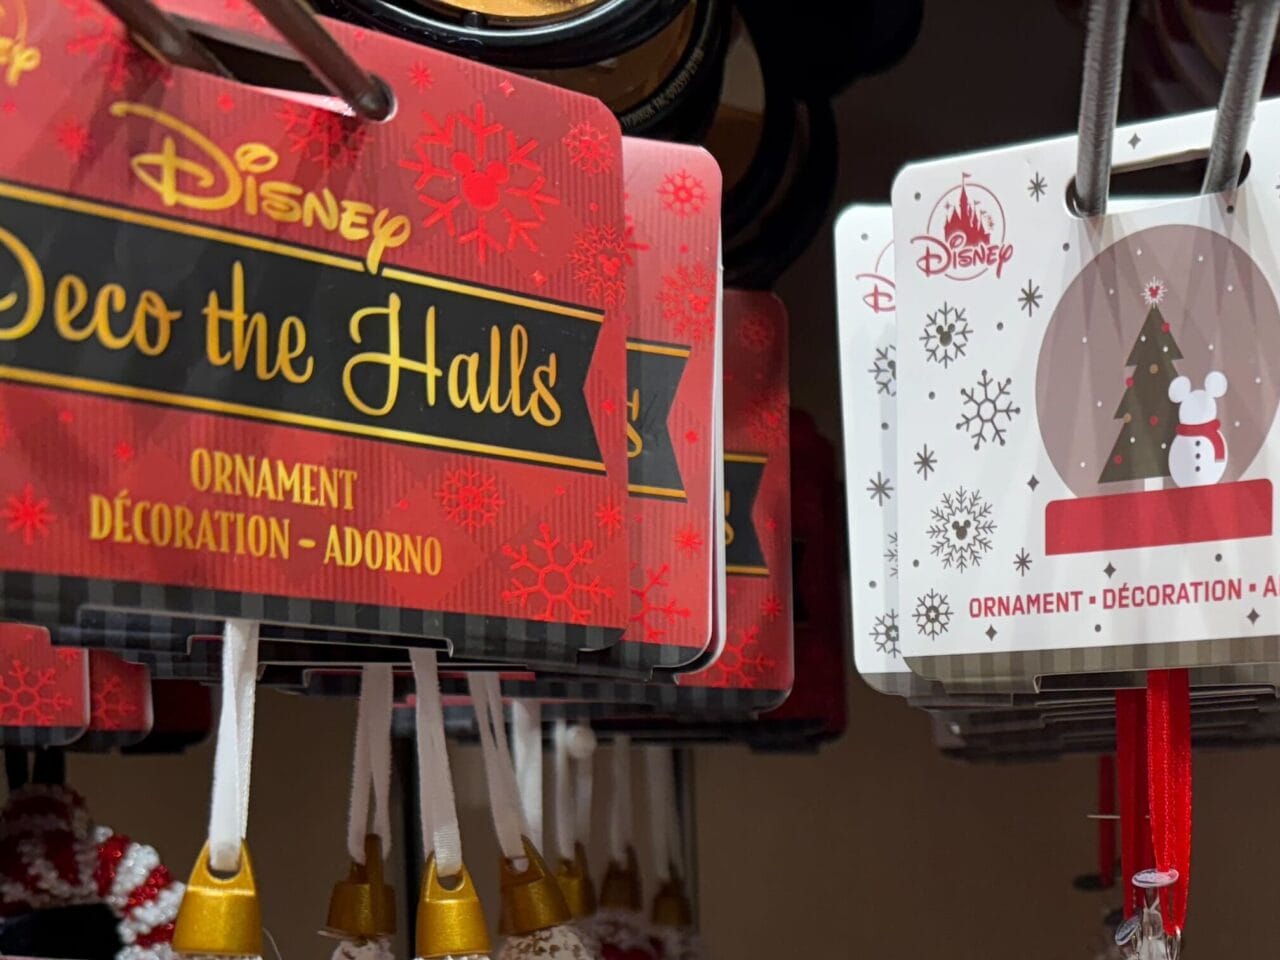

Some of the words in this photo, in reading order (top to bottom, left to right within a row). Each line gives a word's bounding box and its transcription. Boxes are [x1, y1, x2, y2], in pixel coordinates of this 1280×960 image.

[201, 260, 315, 384] the
[342, 292, 562, 428] Halls
[190, 447, 358, 511] ORNAMENT
[88, 488, 291, 560] DÉCORATION
[323, 524, 443, 577] ADORNO
[968, 590, 1084, 619] ORNAMENT
[1102, 577, 1242, 610] DÉCORATION
